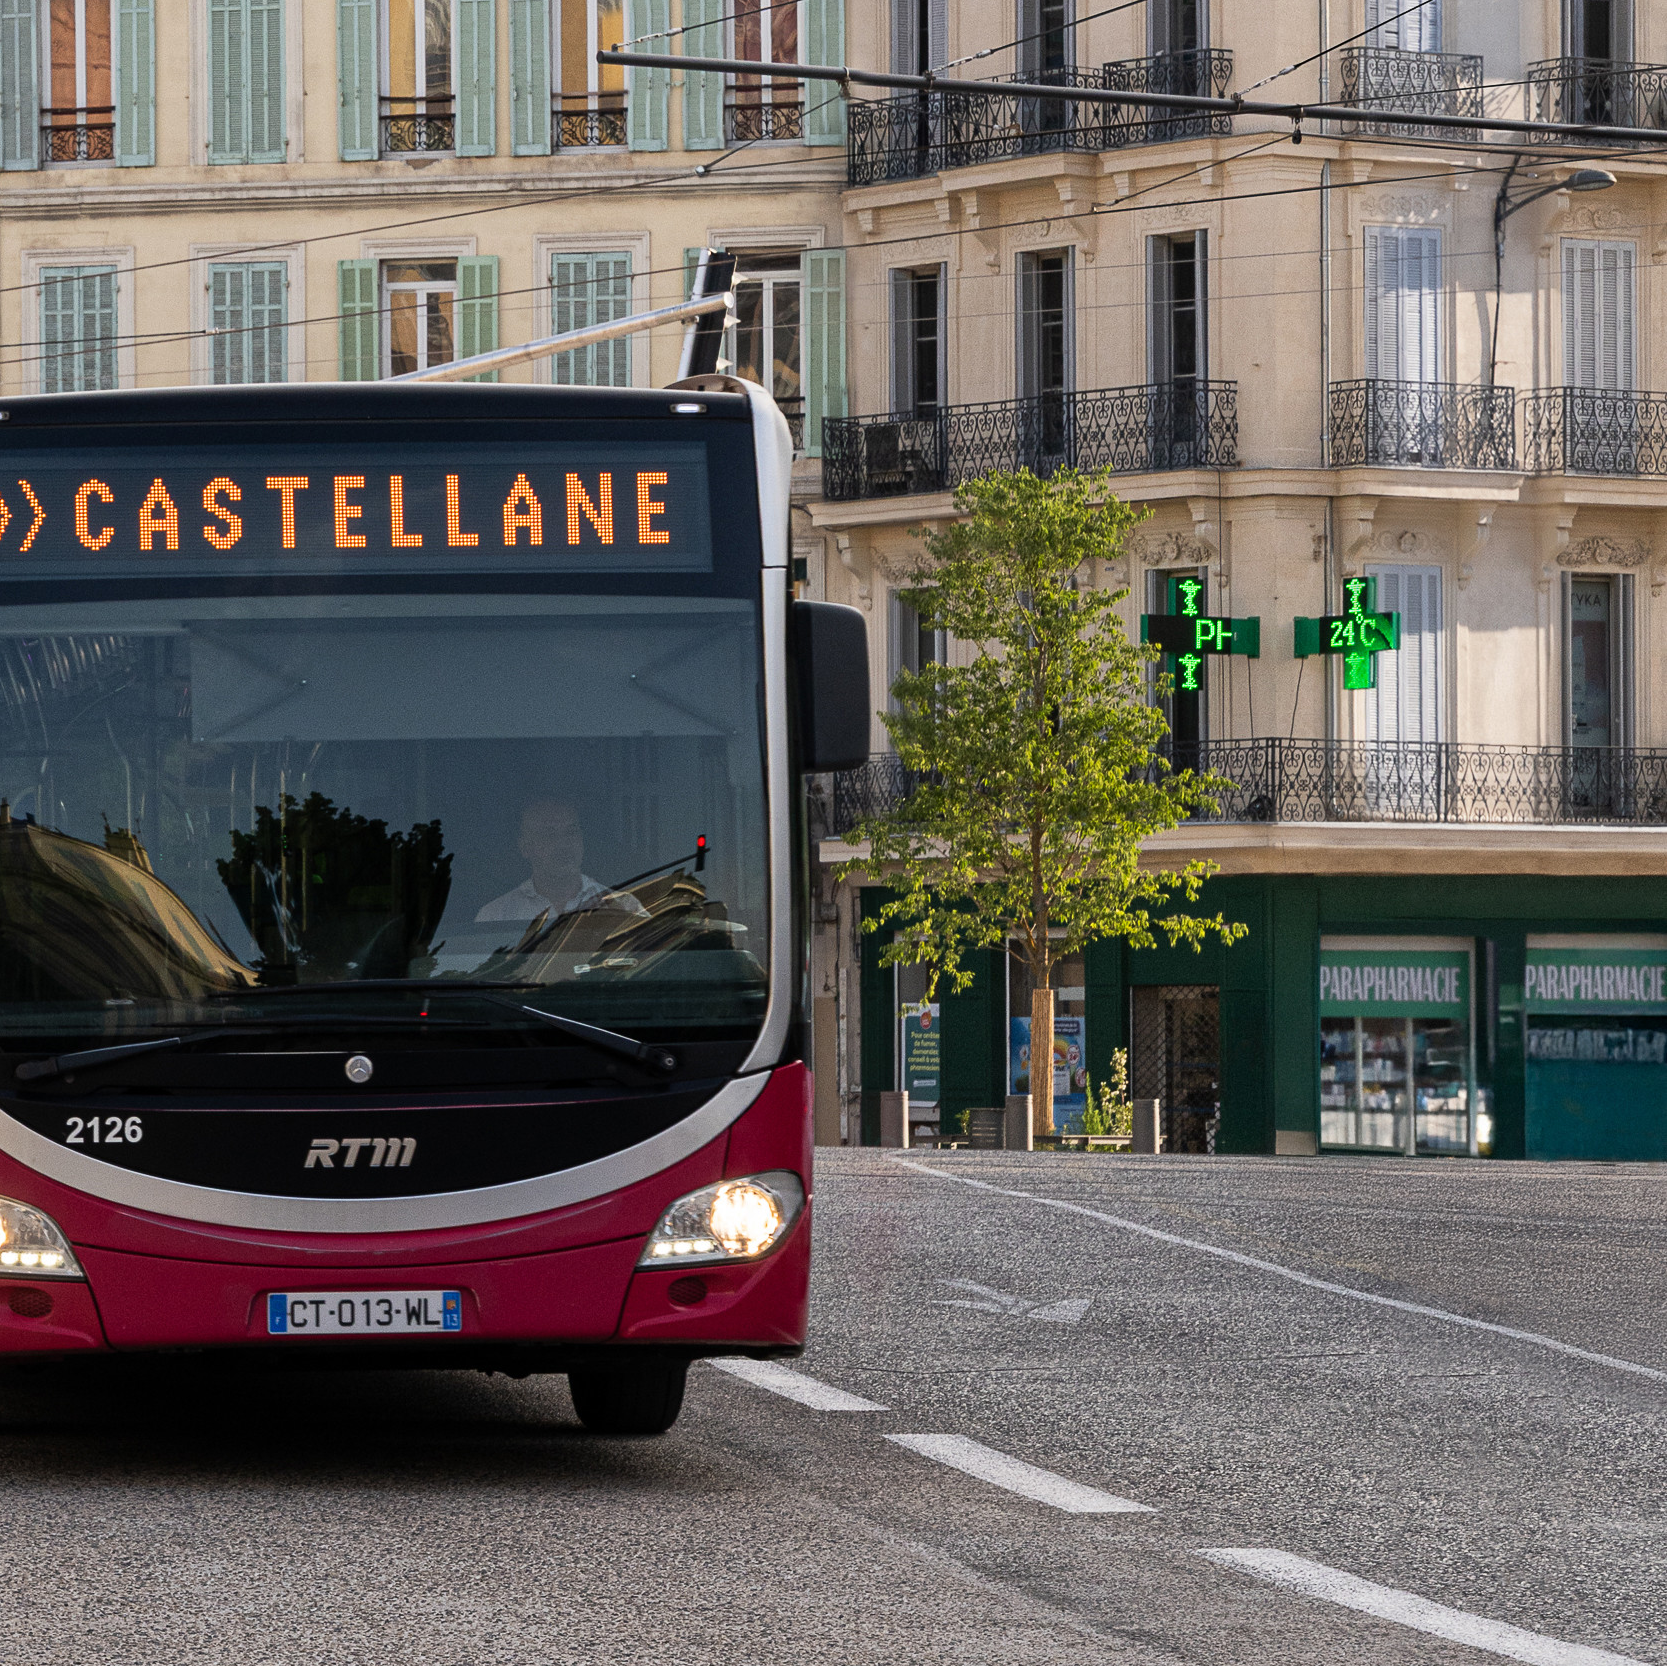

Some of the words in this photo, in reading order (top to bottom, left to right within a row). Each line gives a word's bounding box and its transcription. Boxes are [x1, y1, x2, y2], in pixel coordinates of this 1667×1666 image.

[74, 472, 671, 552] CASTELLANE
[1330, 613, 1376, 648] 24°C
[1320, 965, 1461, 1003] PARAPHARMACIE
[1525, 964, 1667, 1002] PARAPHARMACIE
[66, 1116, 143, 1144] 2126
[303, 1137, 417, 1169] RTM
[290, 1298, 441, 1328] CT-013-WL
[446, 1313, 459, 1326] 13
